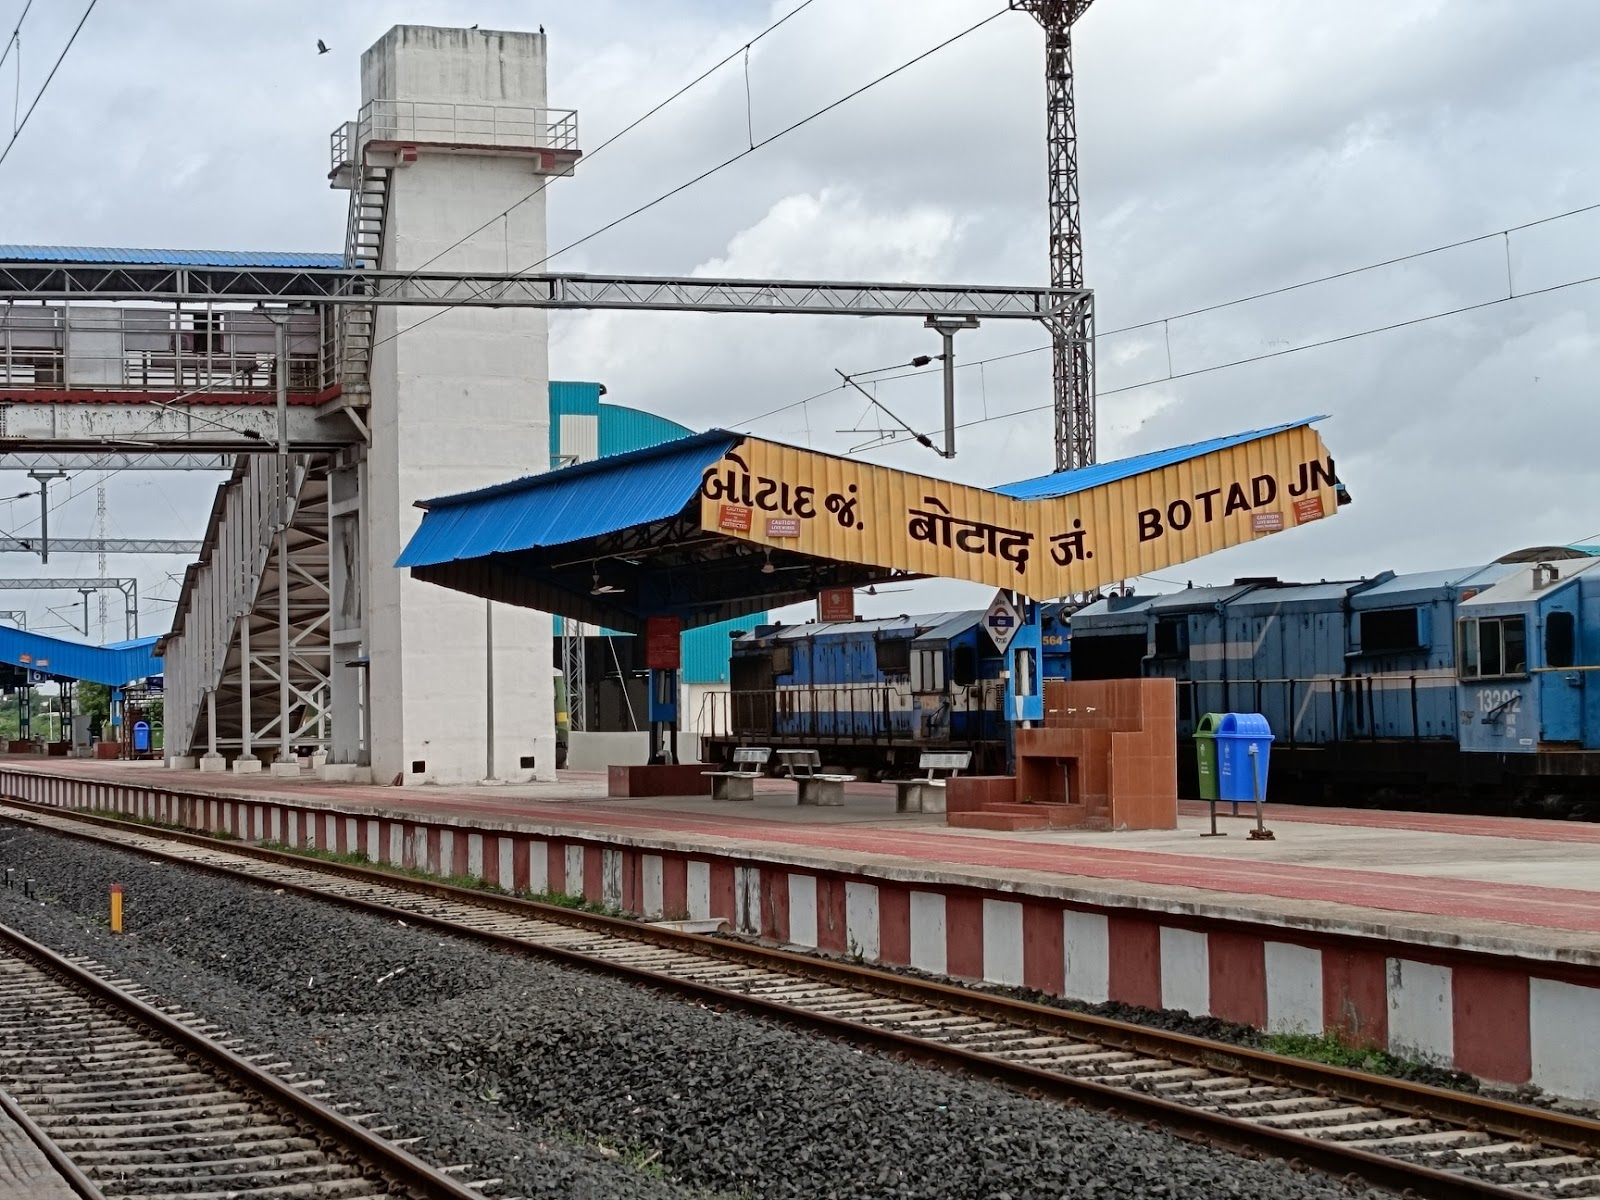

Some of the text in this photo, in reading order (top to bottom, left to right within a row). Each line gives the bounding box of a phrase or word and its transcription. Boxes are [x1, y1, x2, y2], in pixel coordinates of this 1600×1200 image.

[702, 453, 816, 519] બોટાદ
[1138, 455, 1336, 543] BOTAD JN
[908, 496, 1034, 575] बोटाद
[33, 670, 41, 680] 6
